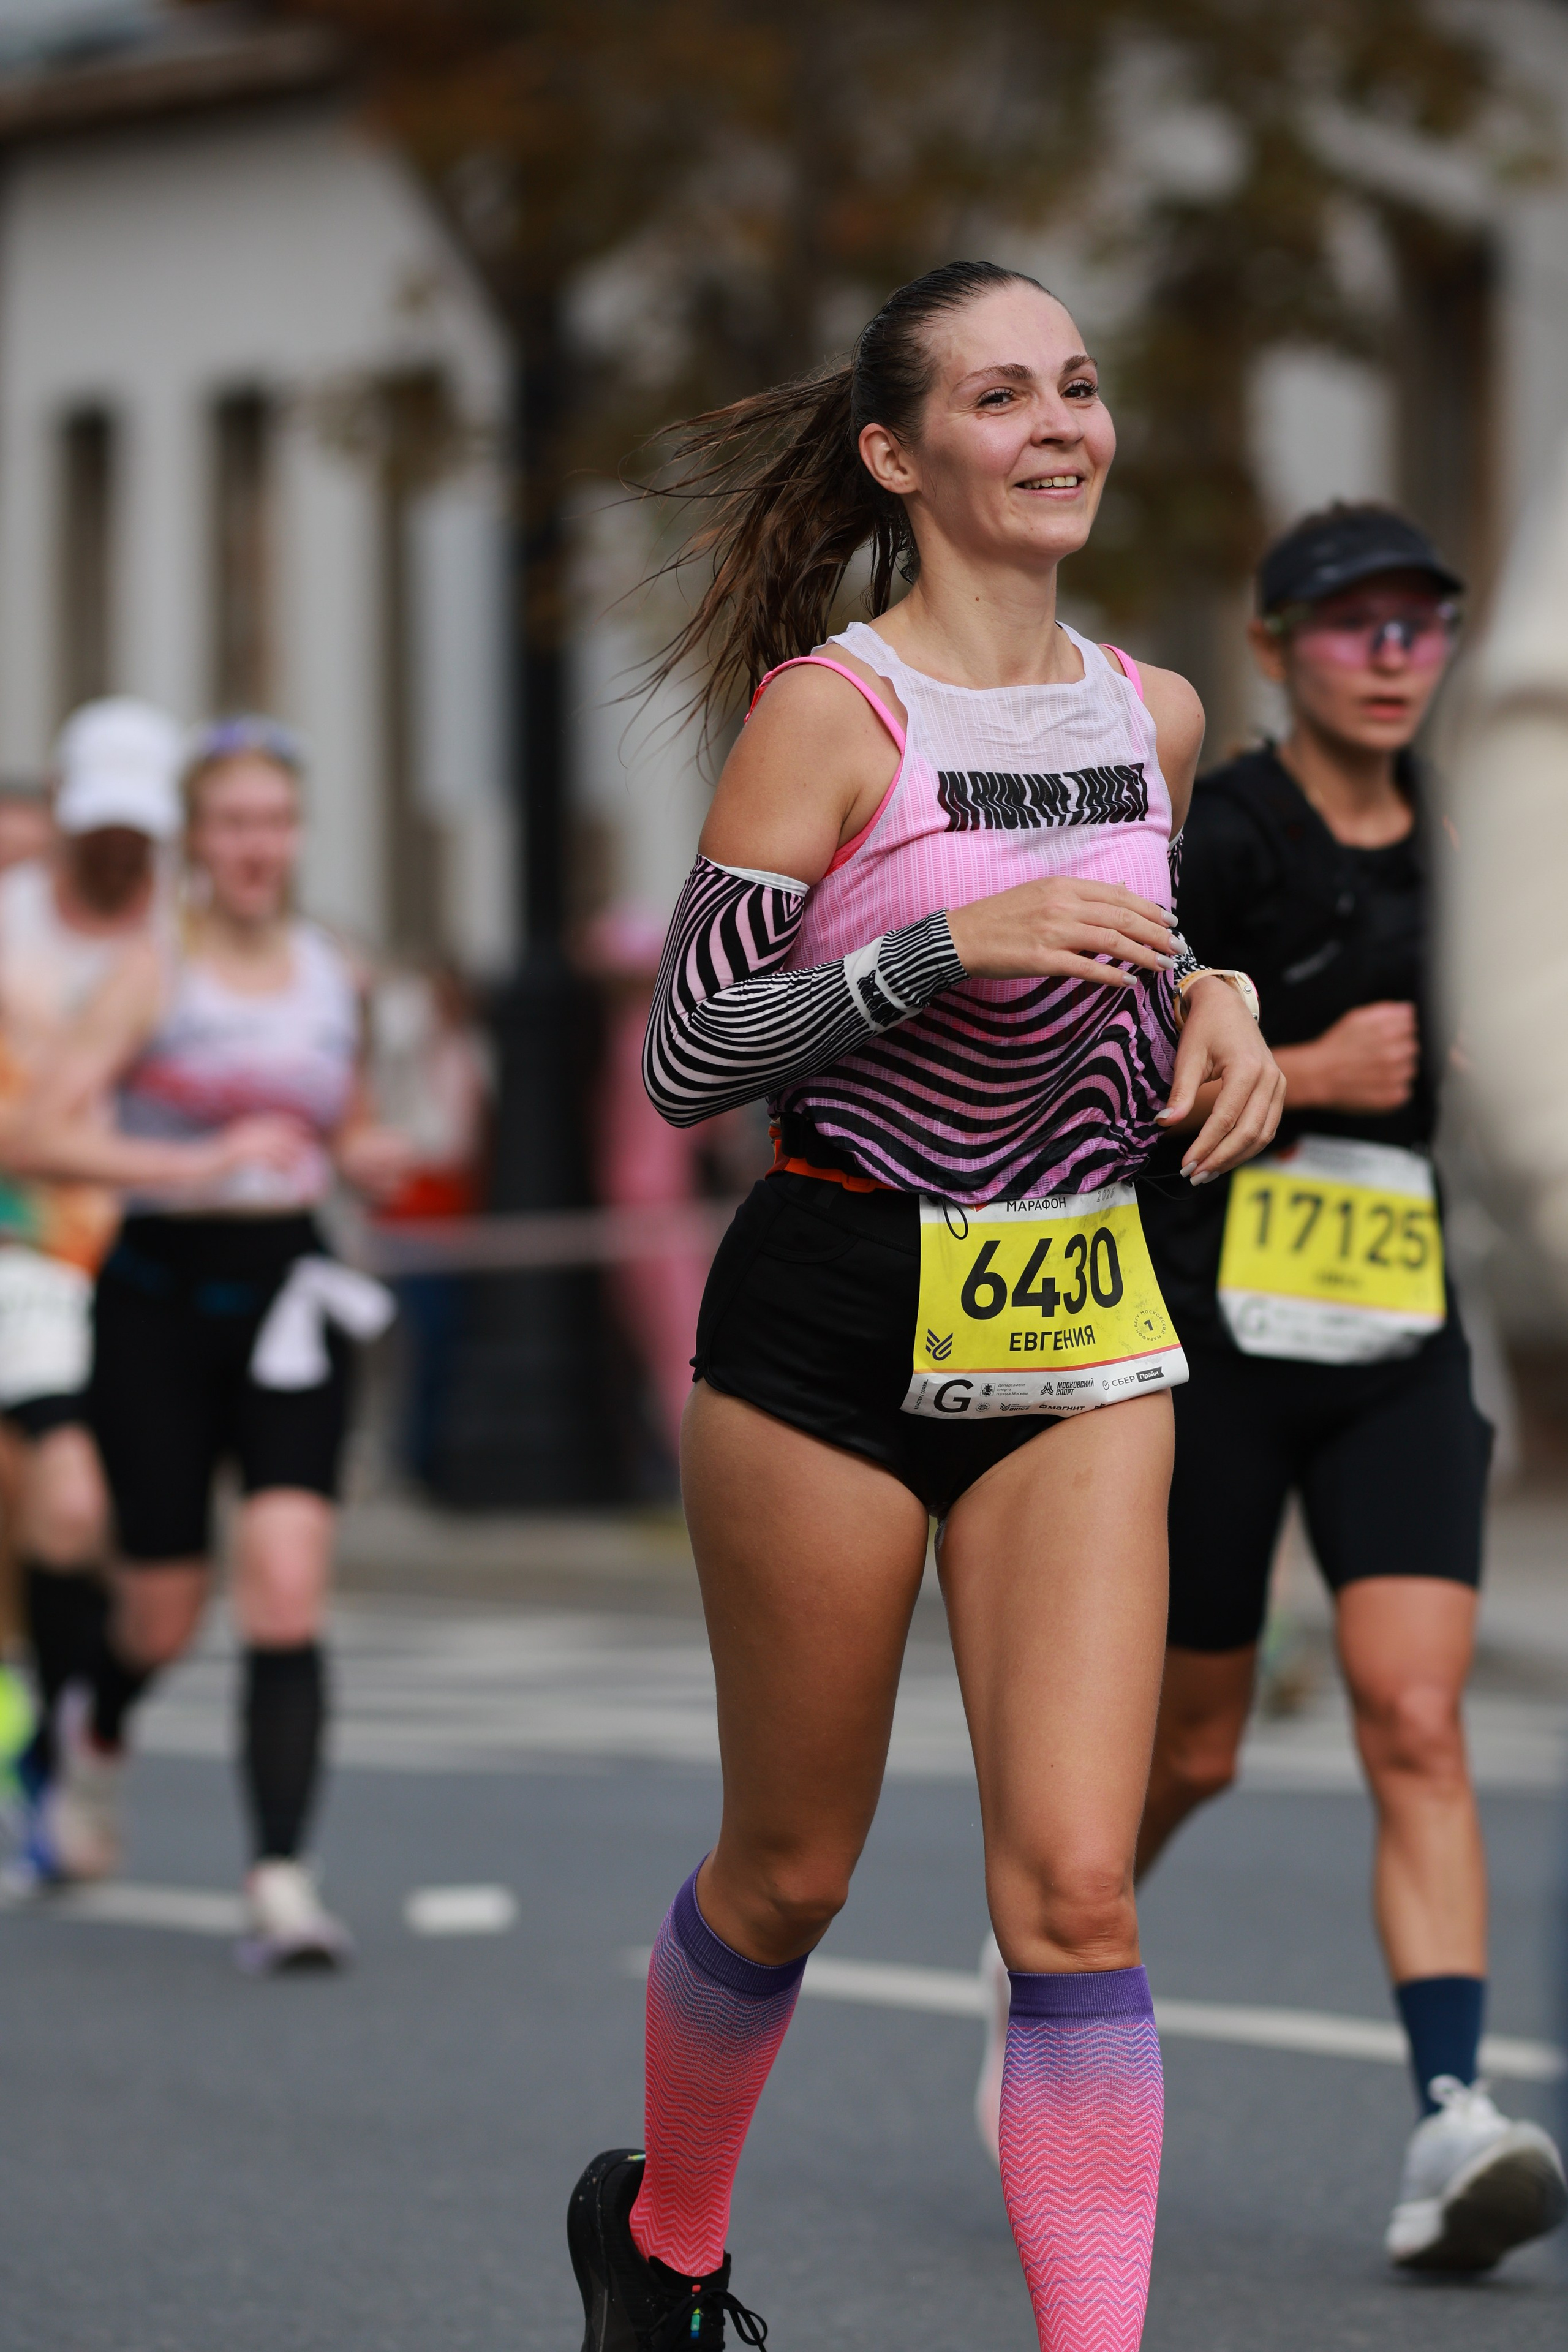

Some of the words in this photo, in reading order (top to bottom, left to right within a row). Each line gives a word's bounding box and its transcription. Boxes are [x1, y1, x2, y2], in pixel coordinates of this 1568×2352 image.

[937, 771, 980, 833] IN
[967, 771, 1041, 830] RUN
[1022, 773, 1084, 828] WE
[1063, 763, 1149, 824] TRUST
[1006, 1197, 1066, 1212] МАРАФОН
[1250, 1186, 1431, 1272] 17125
[960, 1227, 1124, 1321] 6430
[1140, 1310, 1166, 1335] МОСКОВСКИЙ
[1144, 1319, 1153, 1331] 1
[1009, 1325, 1096, 1352] ЕВГЕНИЯ
[1136, 1329, 1161, 1341] МАРАФОН
[920, 1379, 929, 1394] CORRAL
[1057, 1378, 1094, 1389] МОСКОВСКИЙ
[1112, 1375, 1135, 1387] СБЕР
[1139, 1371, 1159, 1379] Прайм
[933, 1379, 974, 1413] G
